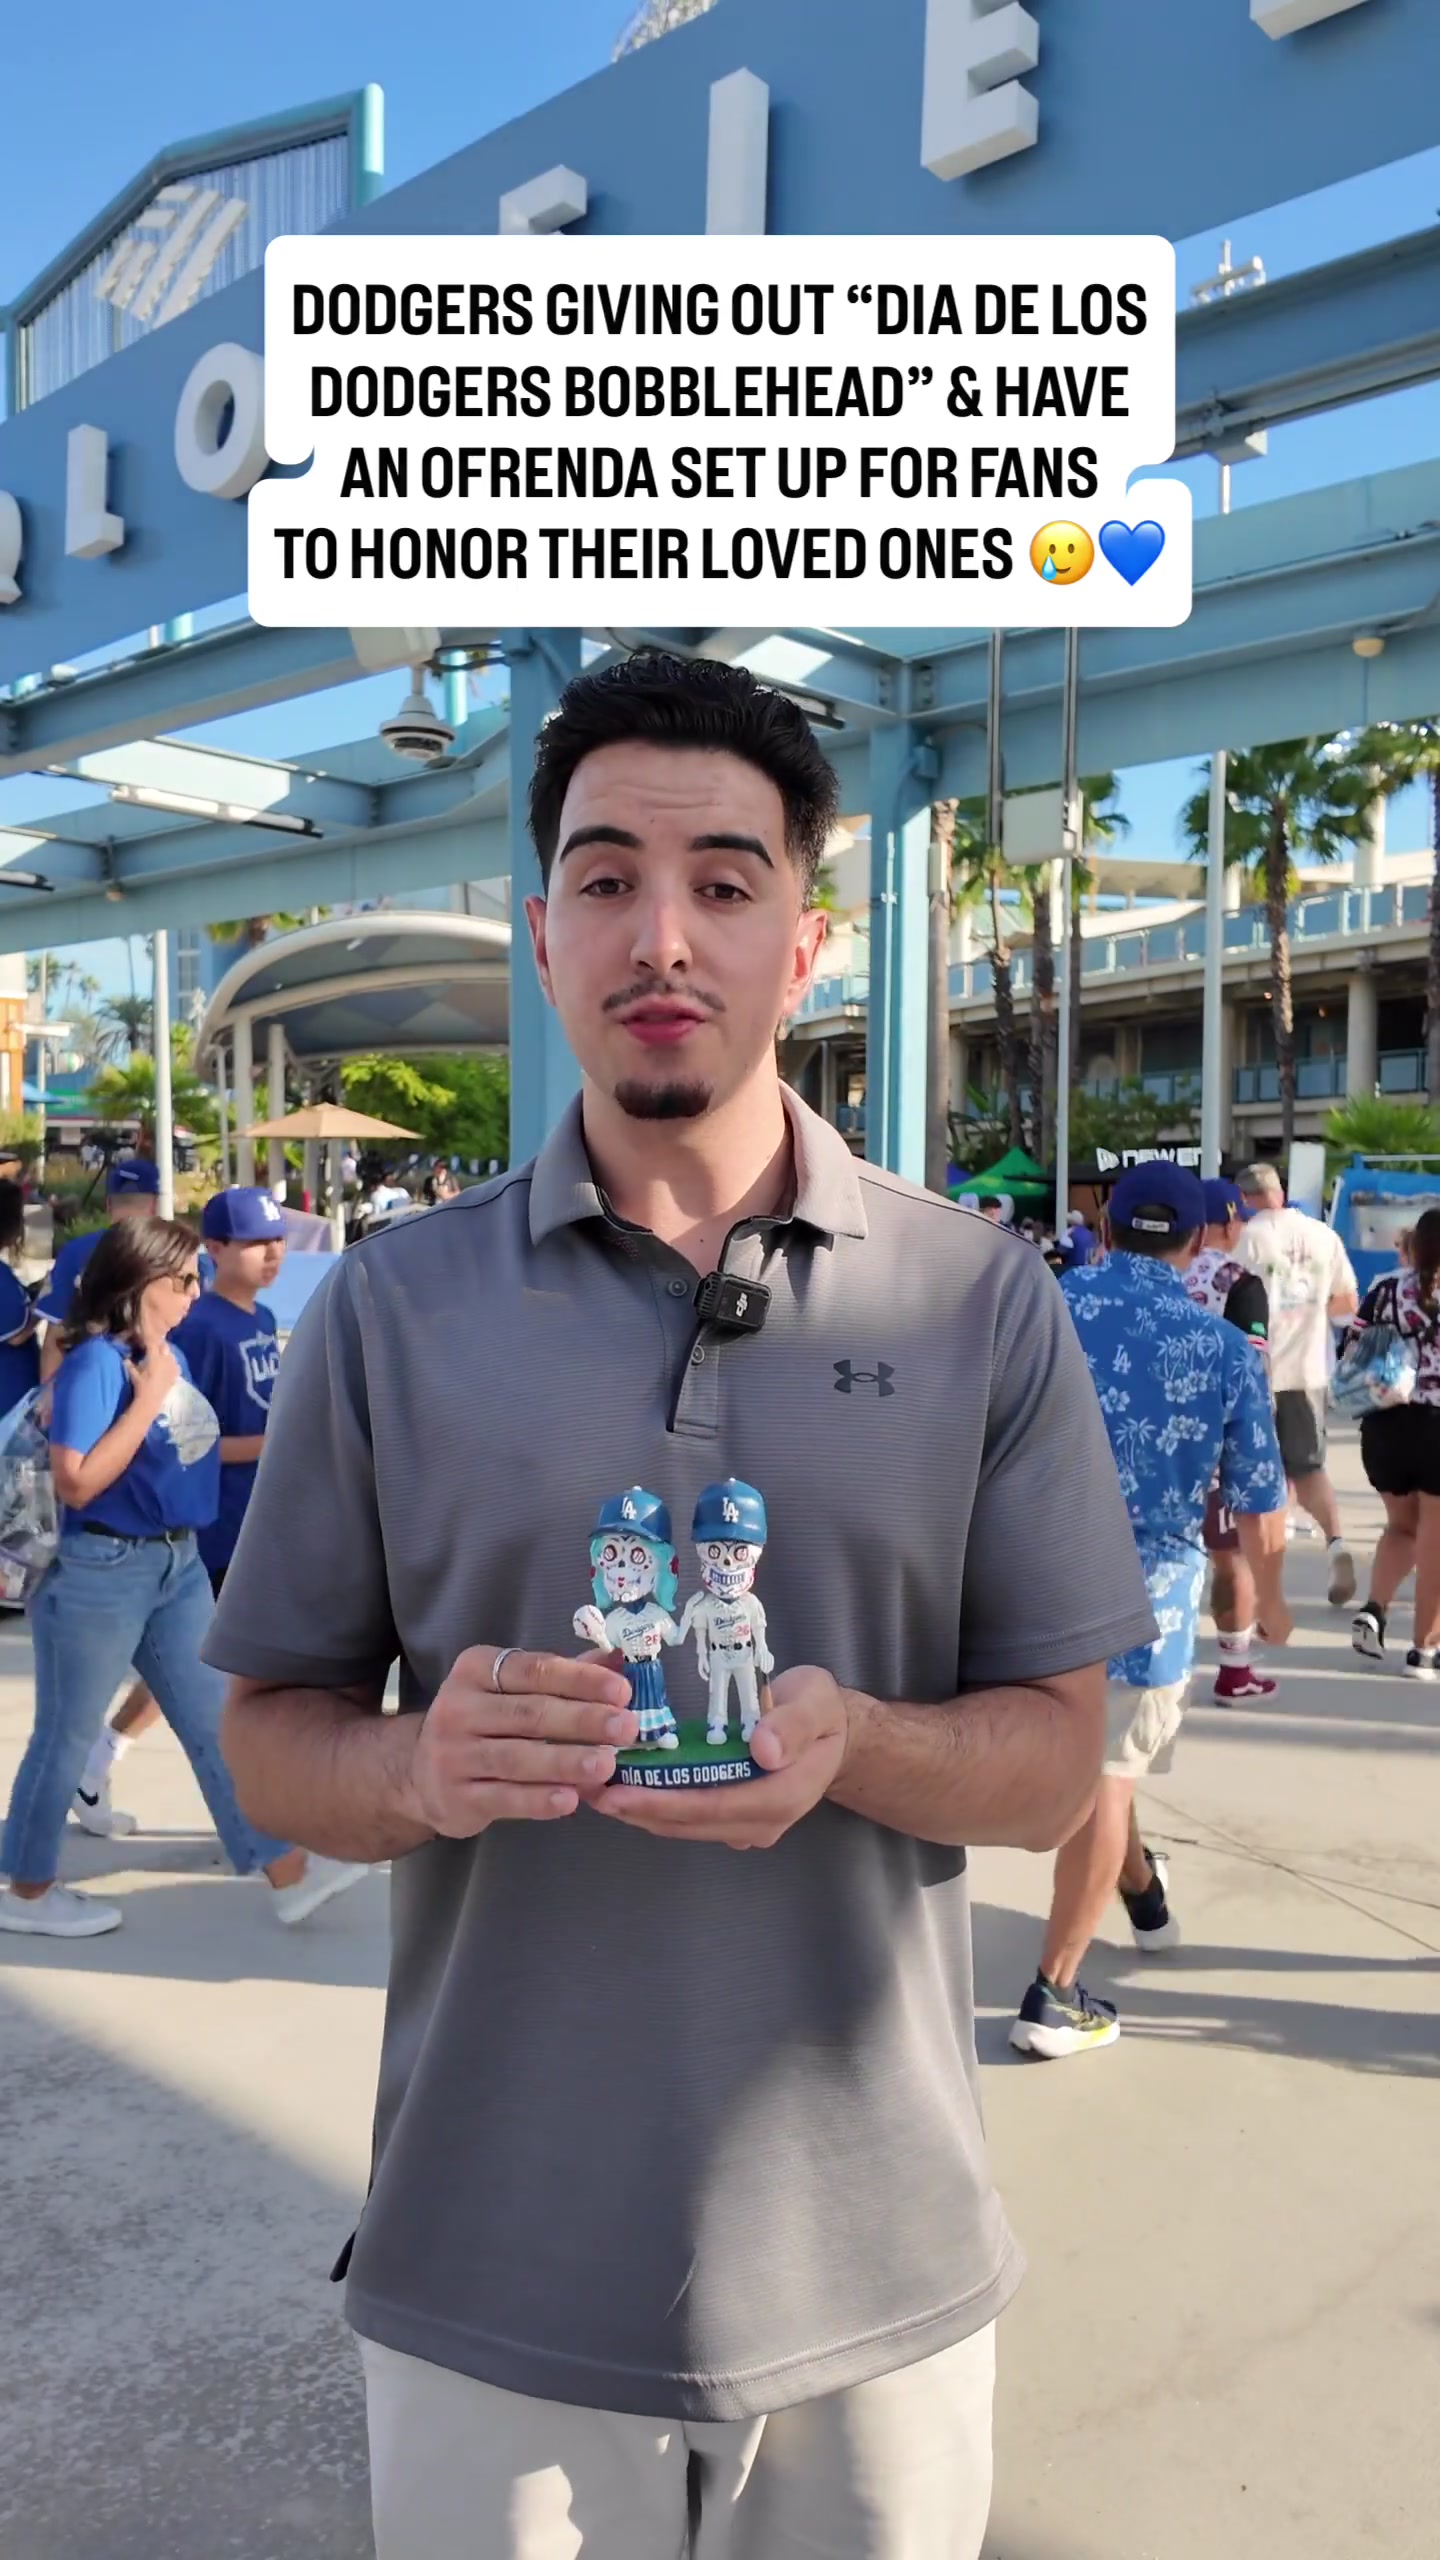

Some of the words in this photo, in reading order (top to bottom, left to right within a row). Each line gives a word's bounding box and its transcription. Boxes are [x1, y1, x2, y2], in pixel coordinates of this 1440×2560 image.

[258, 1196, 281, 1222] LA
[1112, 1344, 1132, 1375] LA
[621, 1496, 637, 1520] LA
[722, 1497, 740, 1523] LA
[620, 1766, 643, 1786] DÍA
[644, 1769, 662, 1786] DE
[664, 1767, 690, 1786] LOS
[693, 1761, 752, 1783] DODGERS
